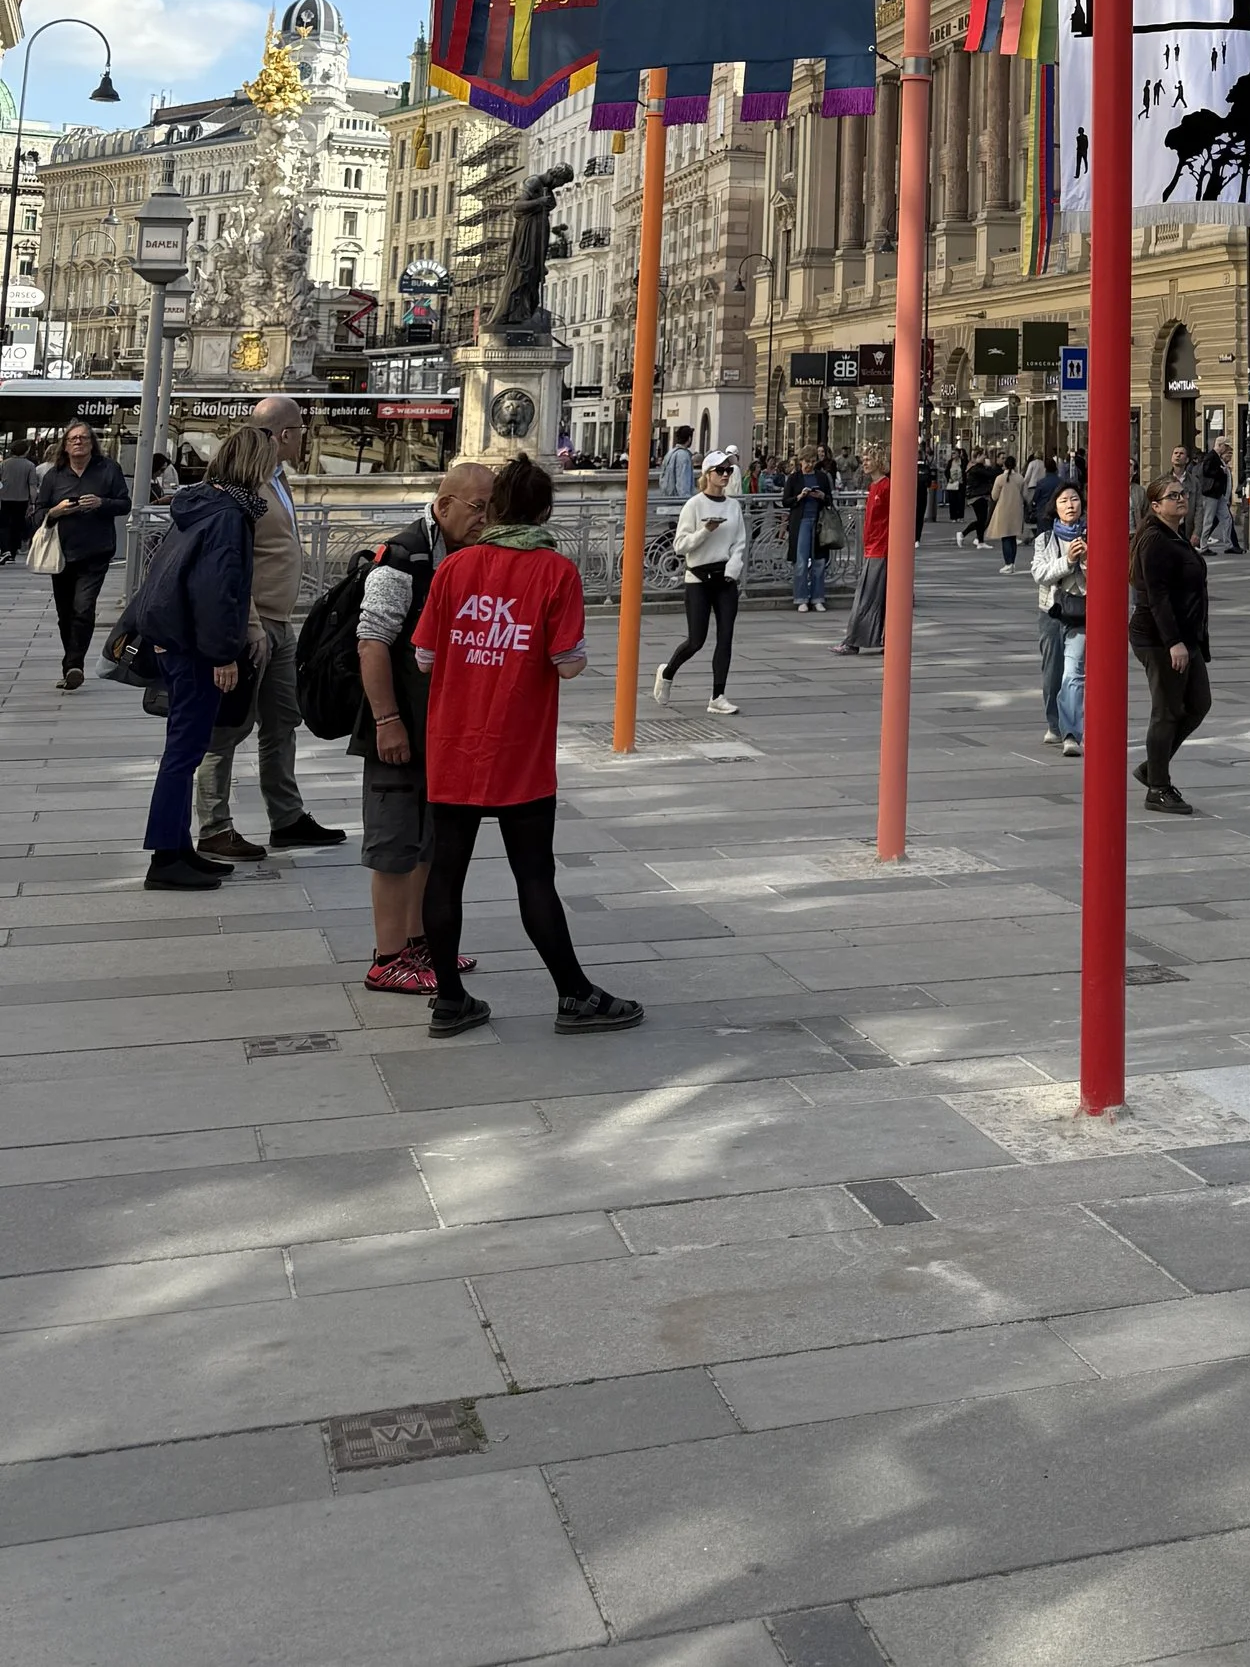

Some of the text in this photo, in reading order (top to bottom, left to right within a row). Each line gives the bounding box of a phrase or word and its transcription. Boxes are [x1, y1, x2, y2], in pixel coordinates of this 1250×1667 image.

[145, 239, 179, 249] DAMEN
[77, 401, 119, 416] sicher
[309, 406, 330, 416] Stadt
[332, 406, 357, 417] gehört
[358, 406, 372, 416] dir.
[456, 594, 517, 624] ASK
[485, 622, 532, 651] ME
[465, 648, 505, 667] MICH
